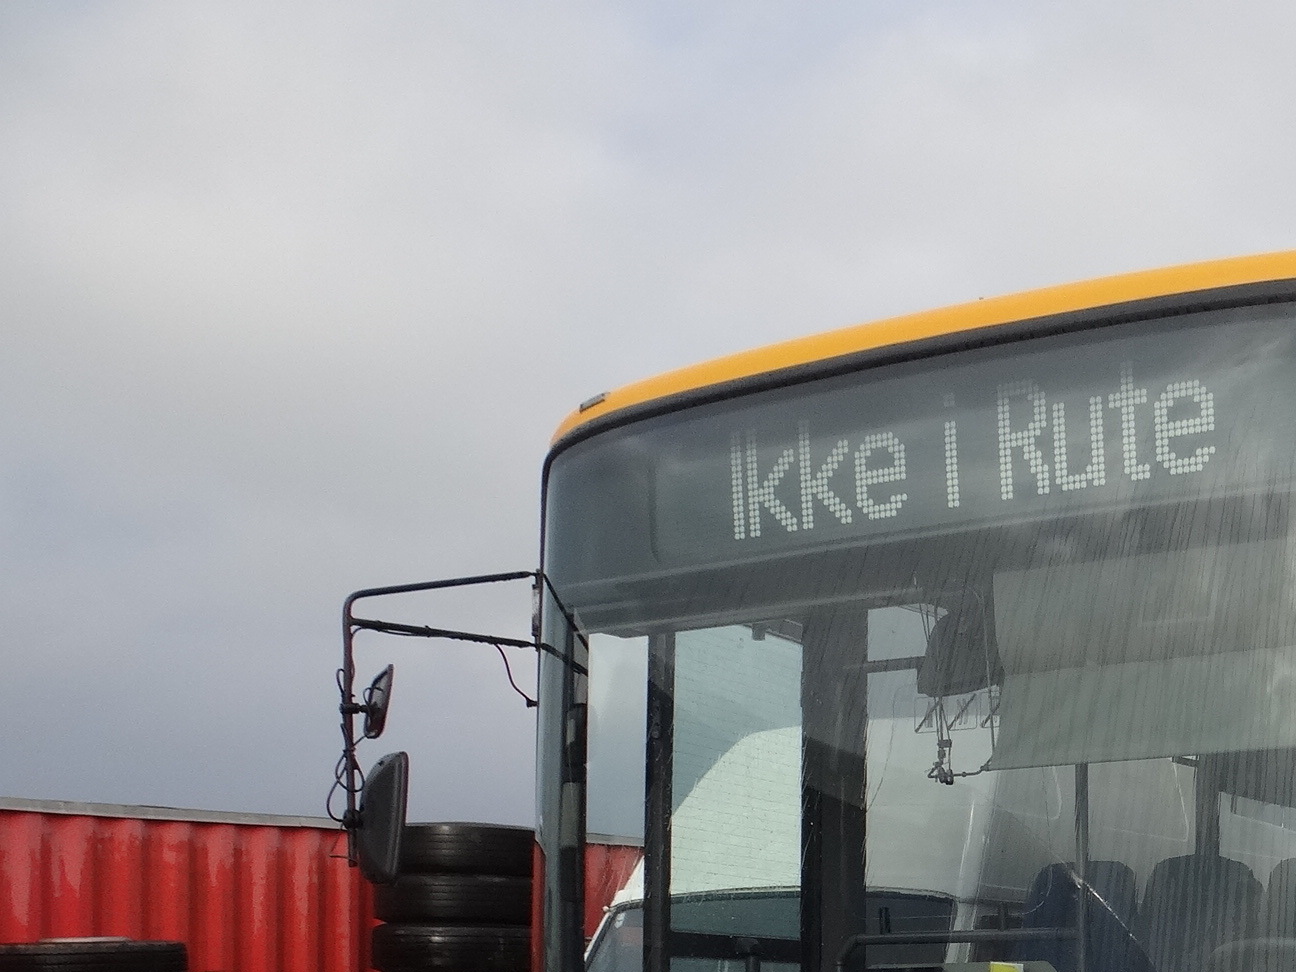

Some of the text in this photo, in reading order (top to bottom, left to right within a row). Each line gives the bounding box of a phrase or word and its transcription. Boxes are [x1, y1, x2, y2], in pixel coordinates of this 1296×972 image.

[731, 362, 1216, 540] Ikke i Rute
